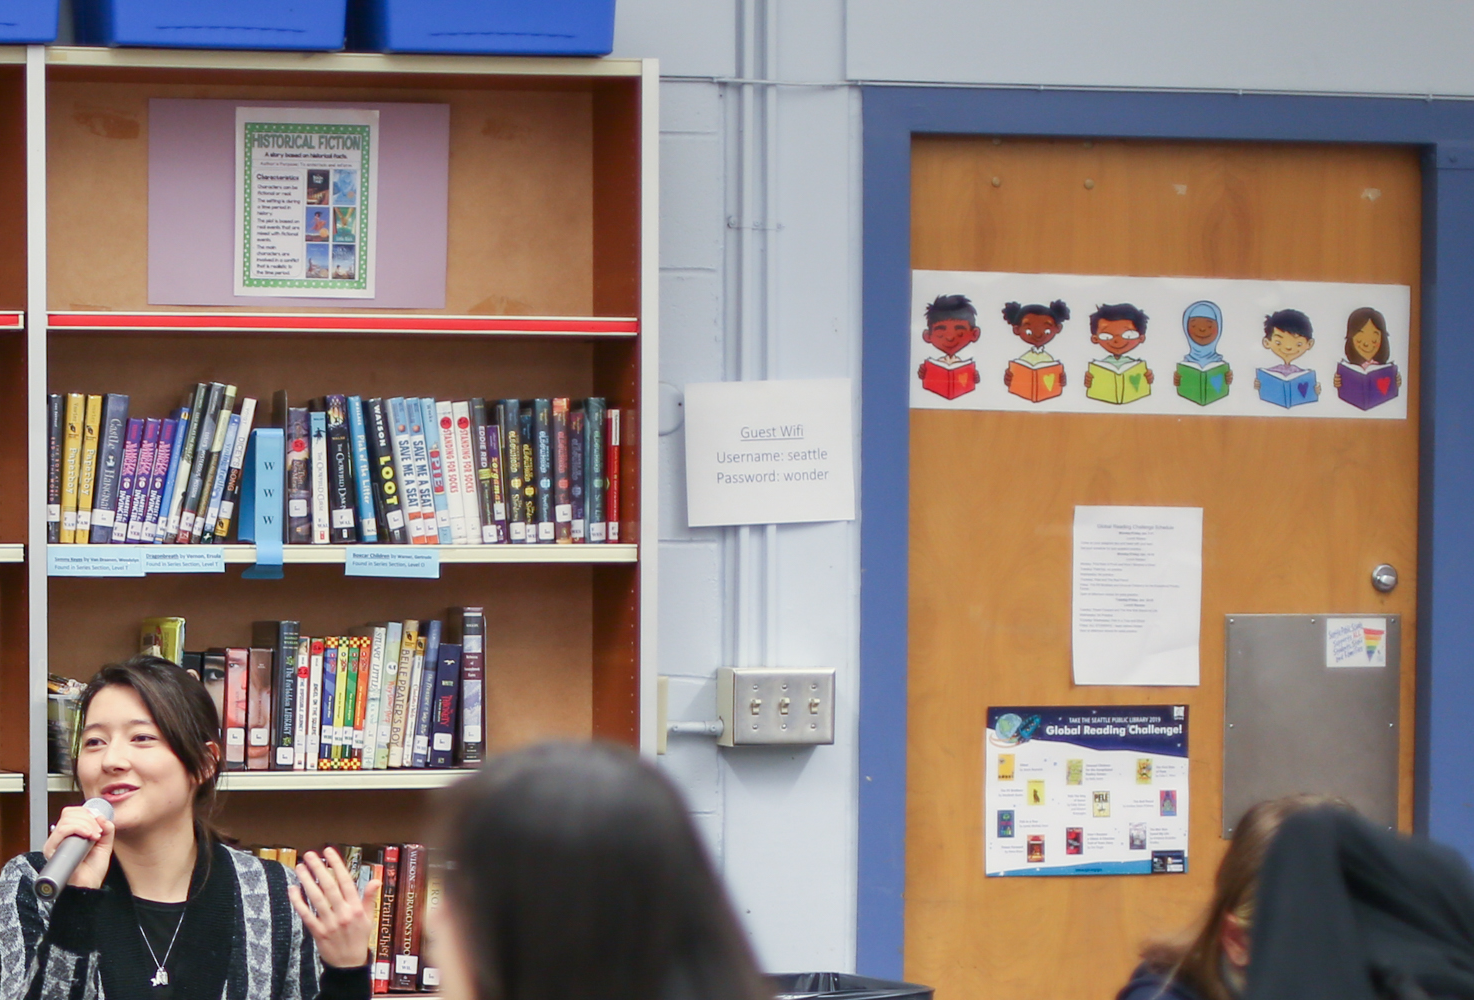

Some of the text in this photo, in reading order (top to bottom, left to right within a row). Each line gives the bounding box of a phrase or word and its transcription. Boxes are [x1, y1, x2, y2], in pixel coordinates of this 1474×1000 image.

[252, 134, 361, 151] HISTORICAL FICTION
[355, 402, 363, 426] WALLACE
[373, 404, 387, 448] WATSON
[106, 418, 124, 450] Castle
[740, 424, 804, 440] Guest Wifi
[398, 440, 410, 462] SAVE
[413, 440, 425, 462] SAVE
[478, 426, 488, 468] EDDIE RED
[716, 447, 828, 464] Username: seattle
[67, 447, 78, 494] Paperboy
[82, 449, 96, 496] Paperboy
[227, 436, 245, 492] DICEY'S SONG
[264, 462, 275, 471] W
[357, 434, 371, 505] Pick of the Litter
[402, 464, 412, 478] ME
[417, 464, 427, 478] ME
[431, 456, 442, 489] PIE
[443, 428, 459, 494] STANDING FOR SOCKS
[459, 428, 474, 494] STANDING FOR SOCKS
[379, 455, 399, 506] LOOT
[716, 468, 829, 484] Password: wonder
[263, 489, 275, 498] W
[407, 487, 419, 508] SEAT
[420, 487, 432, 508] SEAT
[263, 516, 274, 525] W
[398, 648, 411, 677] BELLE
[394, 680, 407, 725] PRATER'S
[1046, 724, 1182, 737] Global Reading Challenge!
[409, 850, 417, 882] WILSON
[378, 893, 394, 958] Prairie Thief
